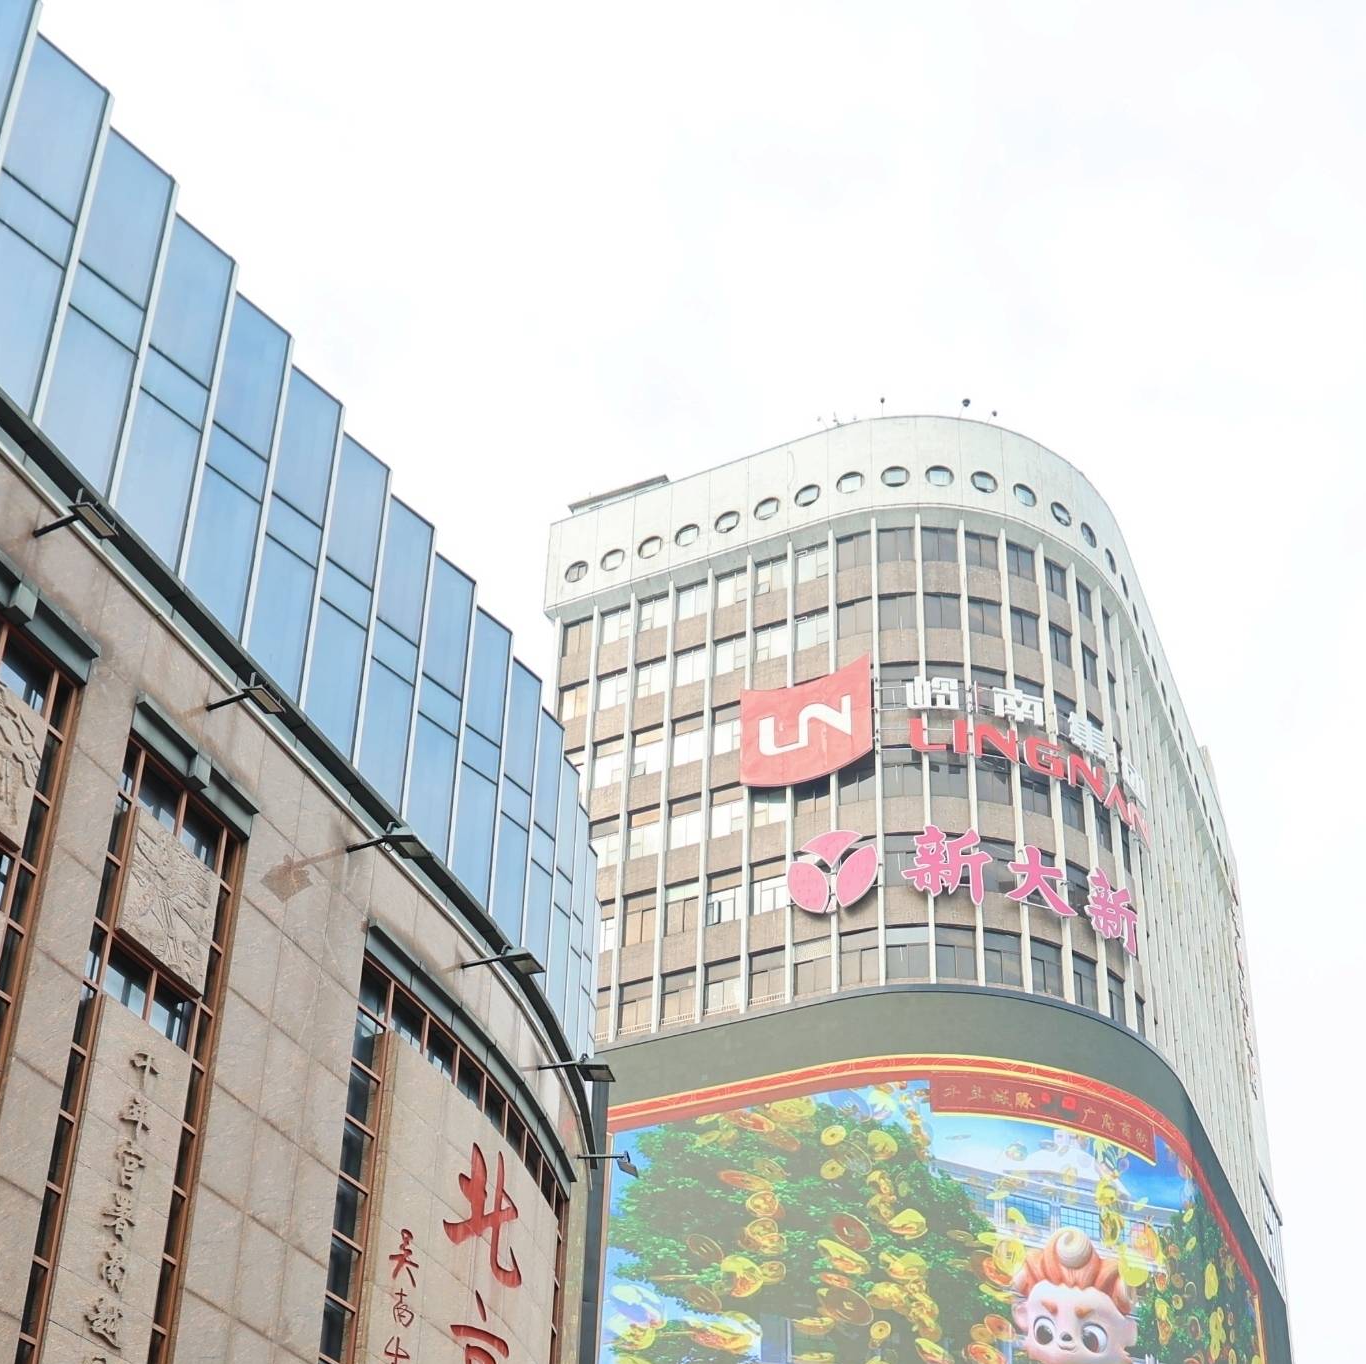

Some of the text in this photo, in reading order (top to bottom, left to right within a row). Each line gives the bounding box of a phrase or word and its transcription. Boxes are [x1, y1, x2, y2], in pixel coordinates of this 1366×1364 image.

[907, 716, 1153, 852] LINGNAN
[900, 823, 1140, 957] 新大新
